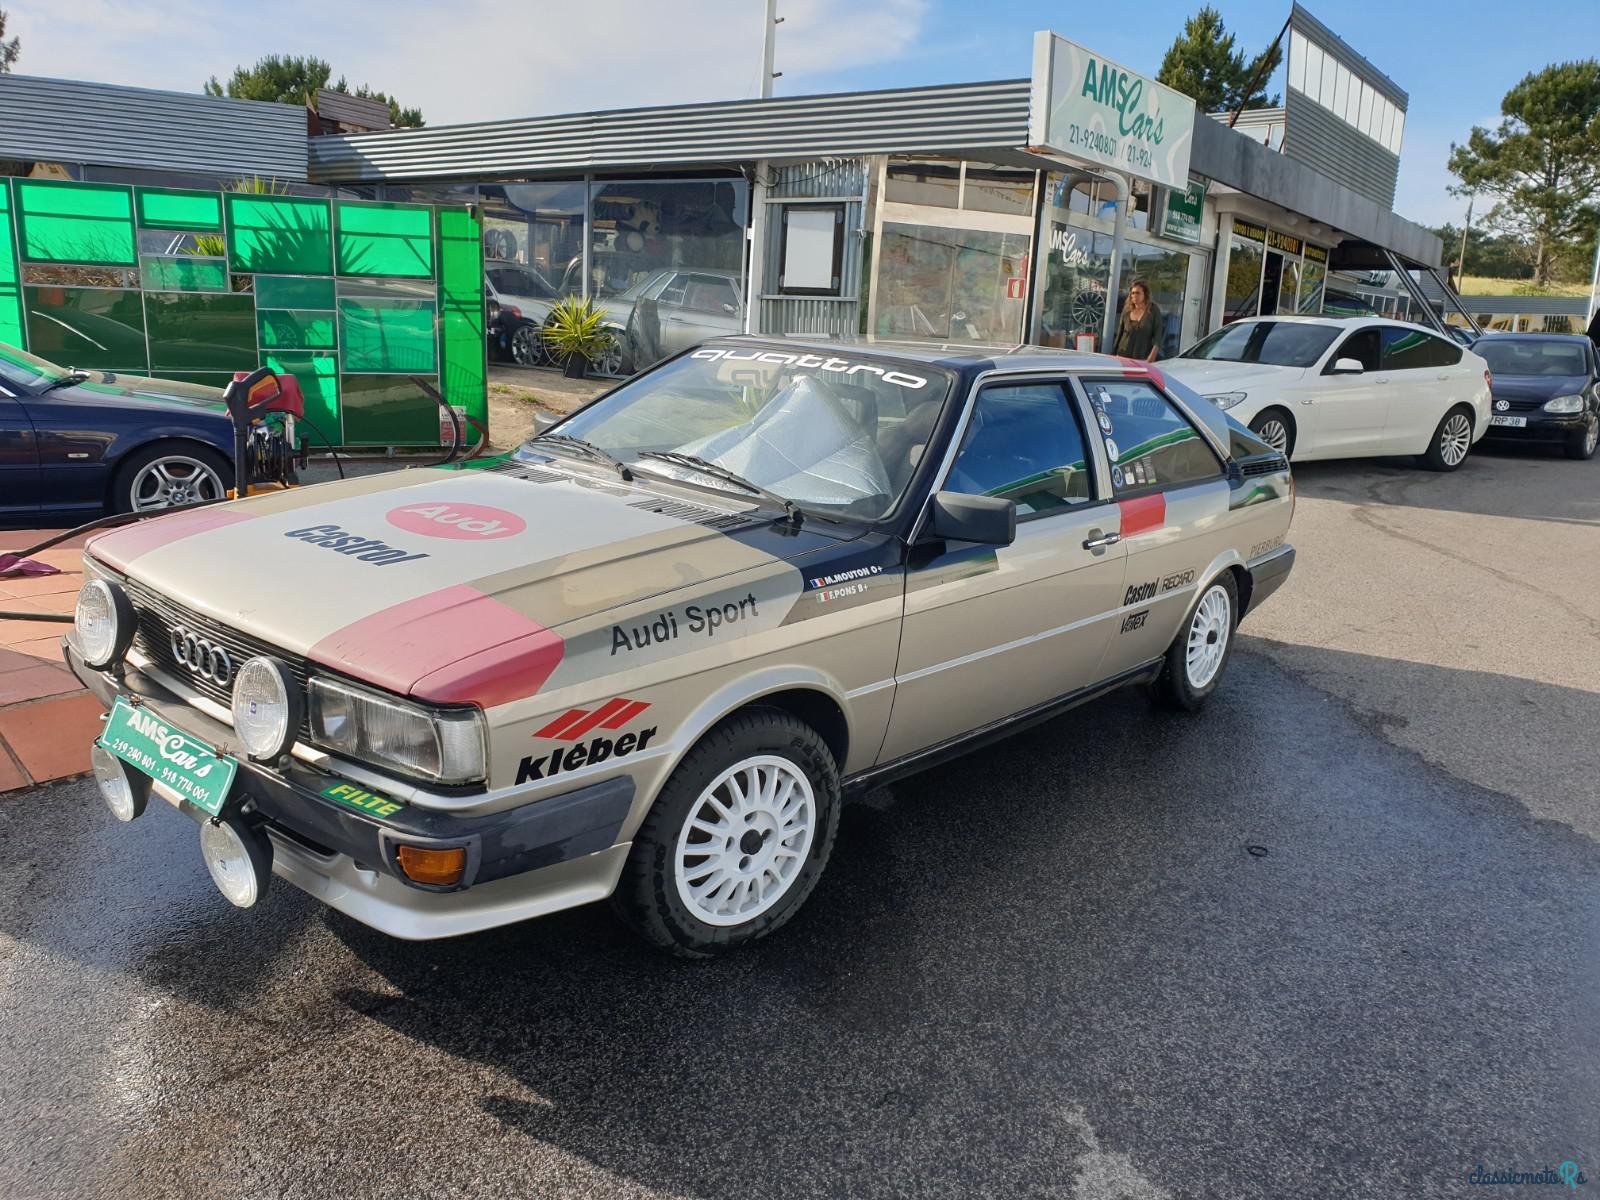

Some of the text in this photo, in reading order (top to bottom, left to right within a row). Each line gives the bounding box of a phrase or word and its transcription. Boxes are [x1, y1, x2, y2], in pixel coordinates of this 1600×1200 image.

[690, 349, 928, 389] quattro
[400, 504, 510, 536] Audi
[284, 524, 431, 567] Castrol
[824, 567, 870, 585] M.MOUTON
[1124, 570, 1194, 606] Castrol RECARO
[610, 593, 759, 656] Audi Sport
[112, 739, 128, 753] 219
[141, 753, 157, 772] 801
[160, 768, 177, 783] 918
[176, 776, 193, 792] 774
[192, 785, 210, 802] 001
